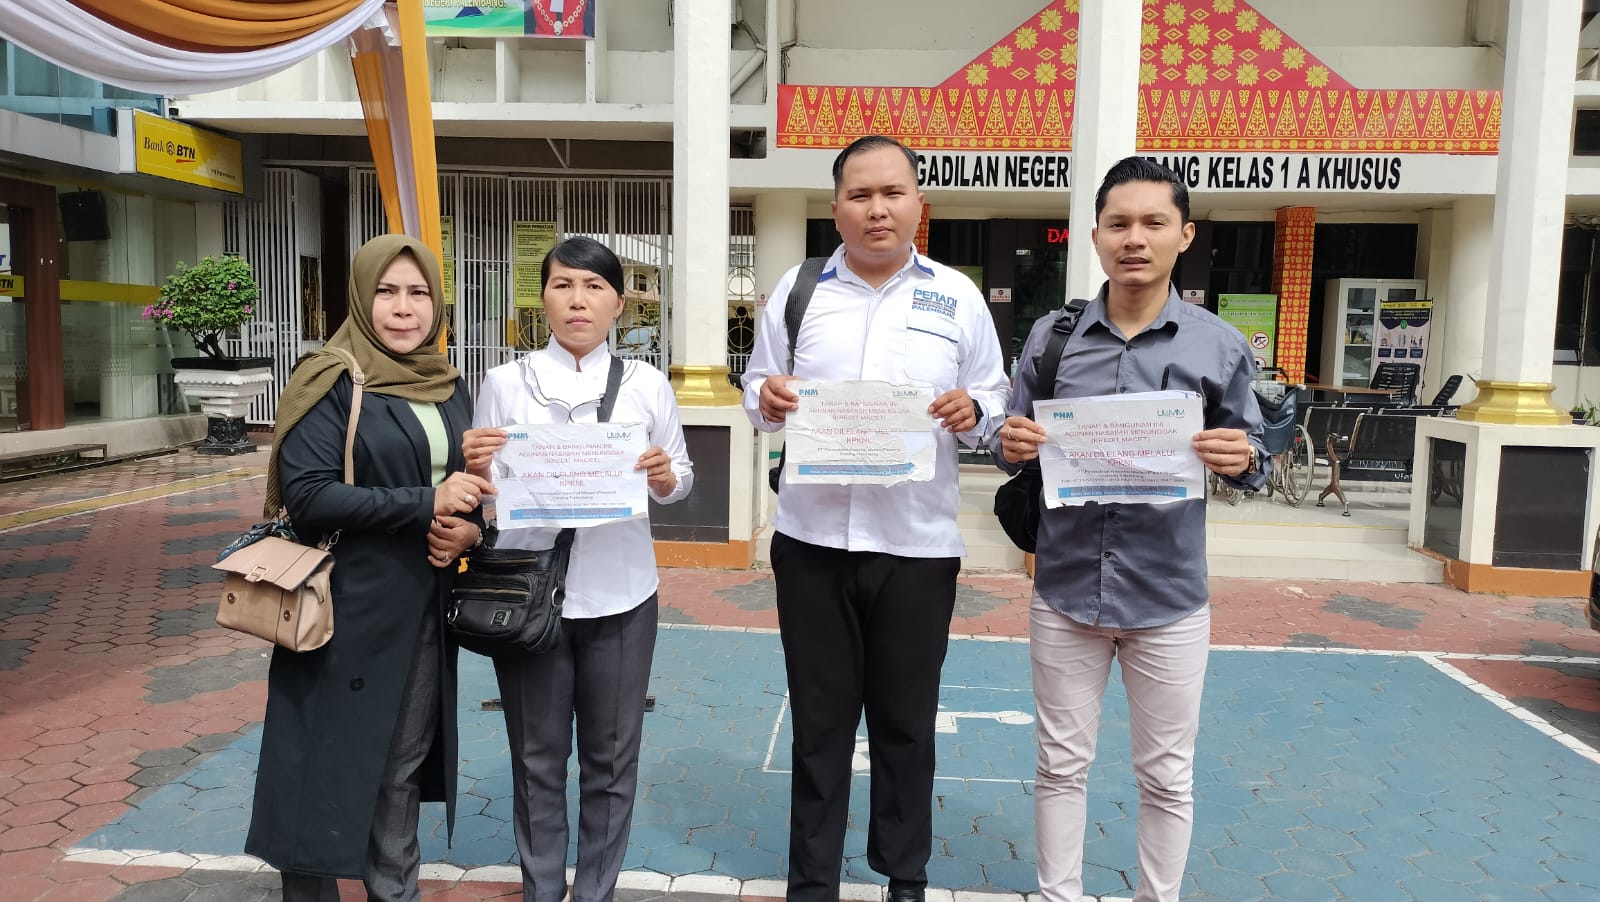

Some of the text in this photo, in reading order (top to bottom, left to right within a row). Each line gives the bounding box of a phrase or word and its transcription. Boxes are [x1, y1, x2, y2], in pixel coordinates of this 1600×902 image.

[144, 136, 196, 159] Bank BTN
[917, 154, 999, 187] GADILAN
[1005, 155, 1073, 188] NEGER
[1207, 156, 1274, 188] KELAS
[1280, 156, 1290, 188] 1
[1296, 157, 1310, 189] A
[1317, 157, 1402, 190] KHUSUS
[913, 288, 958, 309] PERADI
[507, 432, 528, 440] PNM
